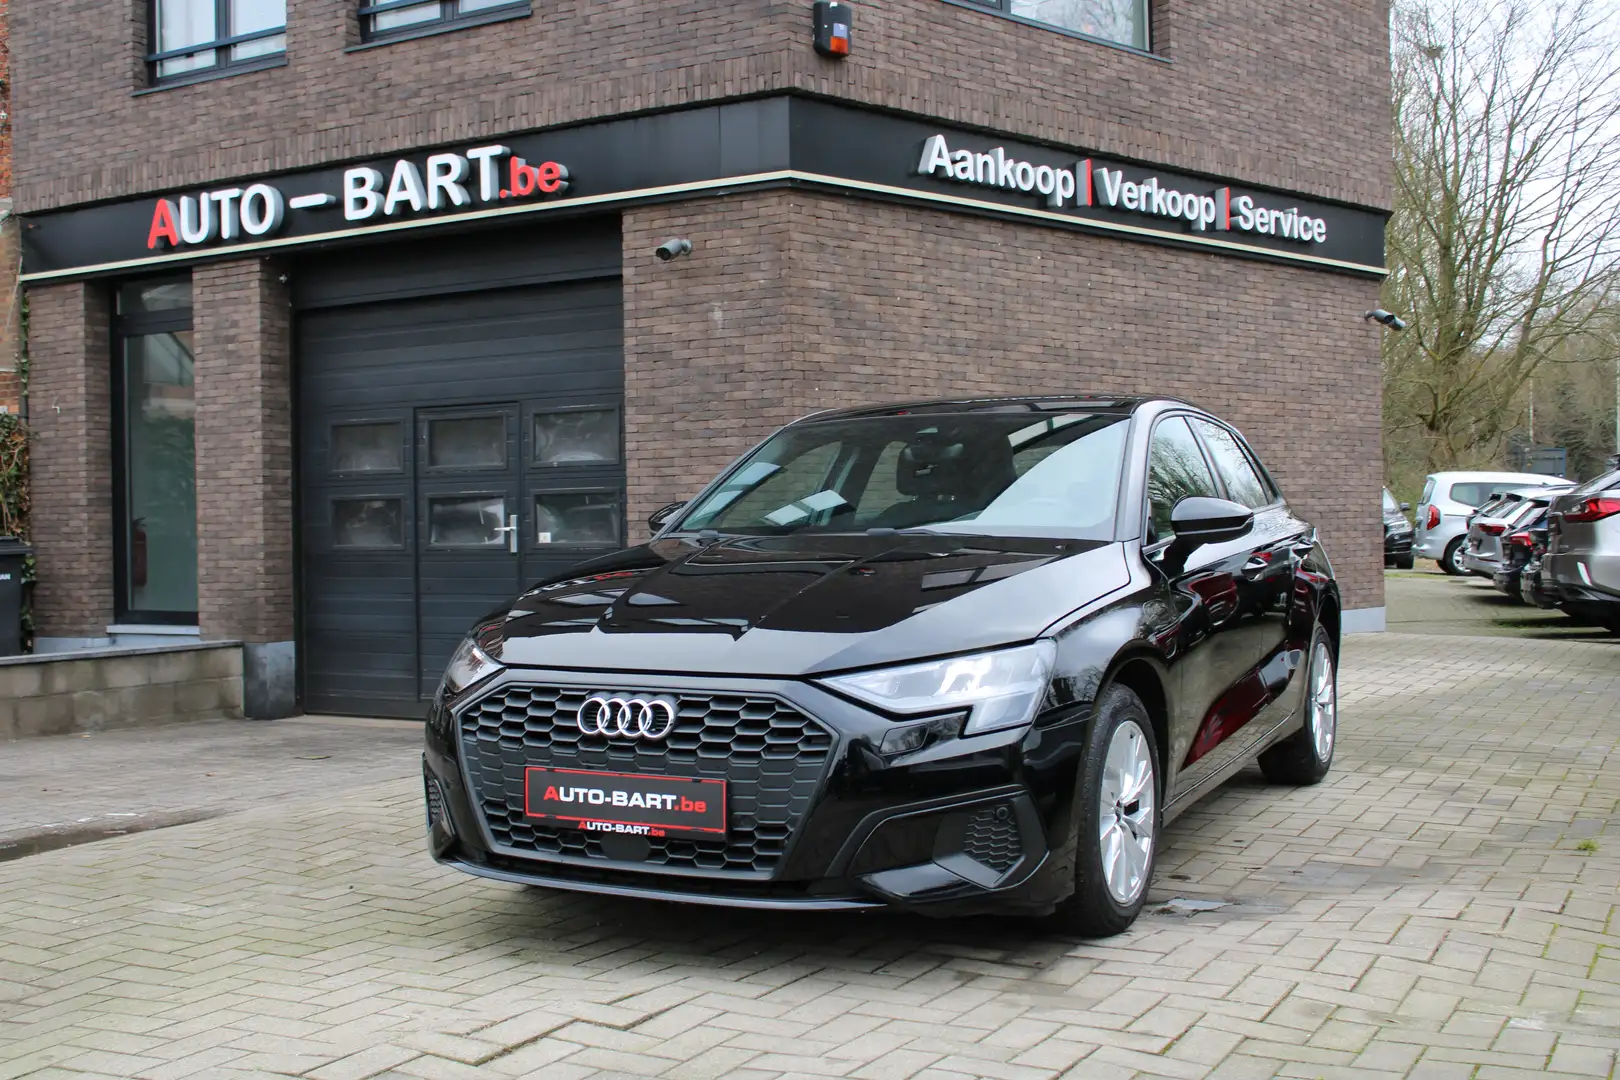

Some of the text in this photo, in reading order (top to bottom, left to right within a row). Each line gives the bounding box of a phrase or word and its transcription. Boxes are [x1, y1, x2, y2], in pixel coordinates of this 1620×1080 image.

[919, 134, 1327, 244] Aankoop Verkoop Service
[543, 785, 707, 813] AUTO-BART.be
[578, 821, 666, 837] AUTO-BART.be
